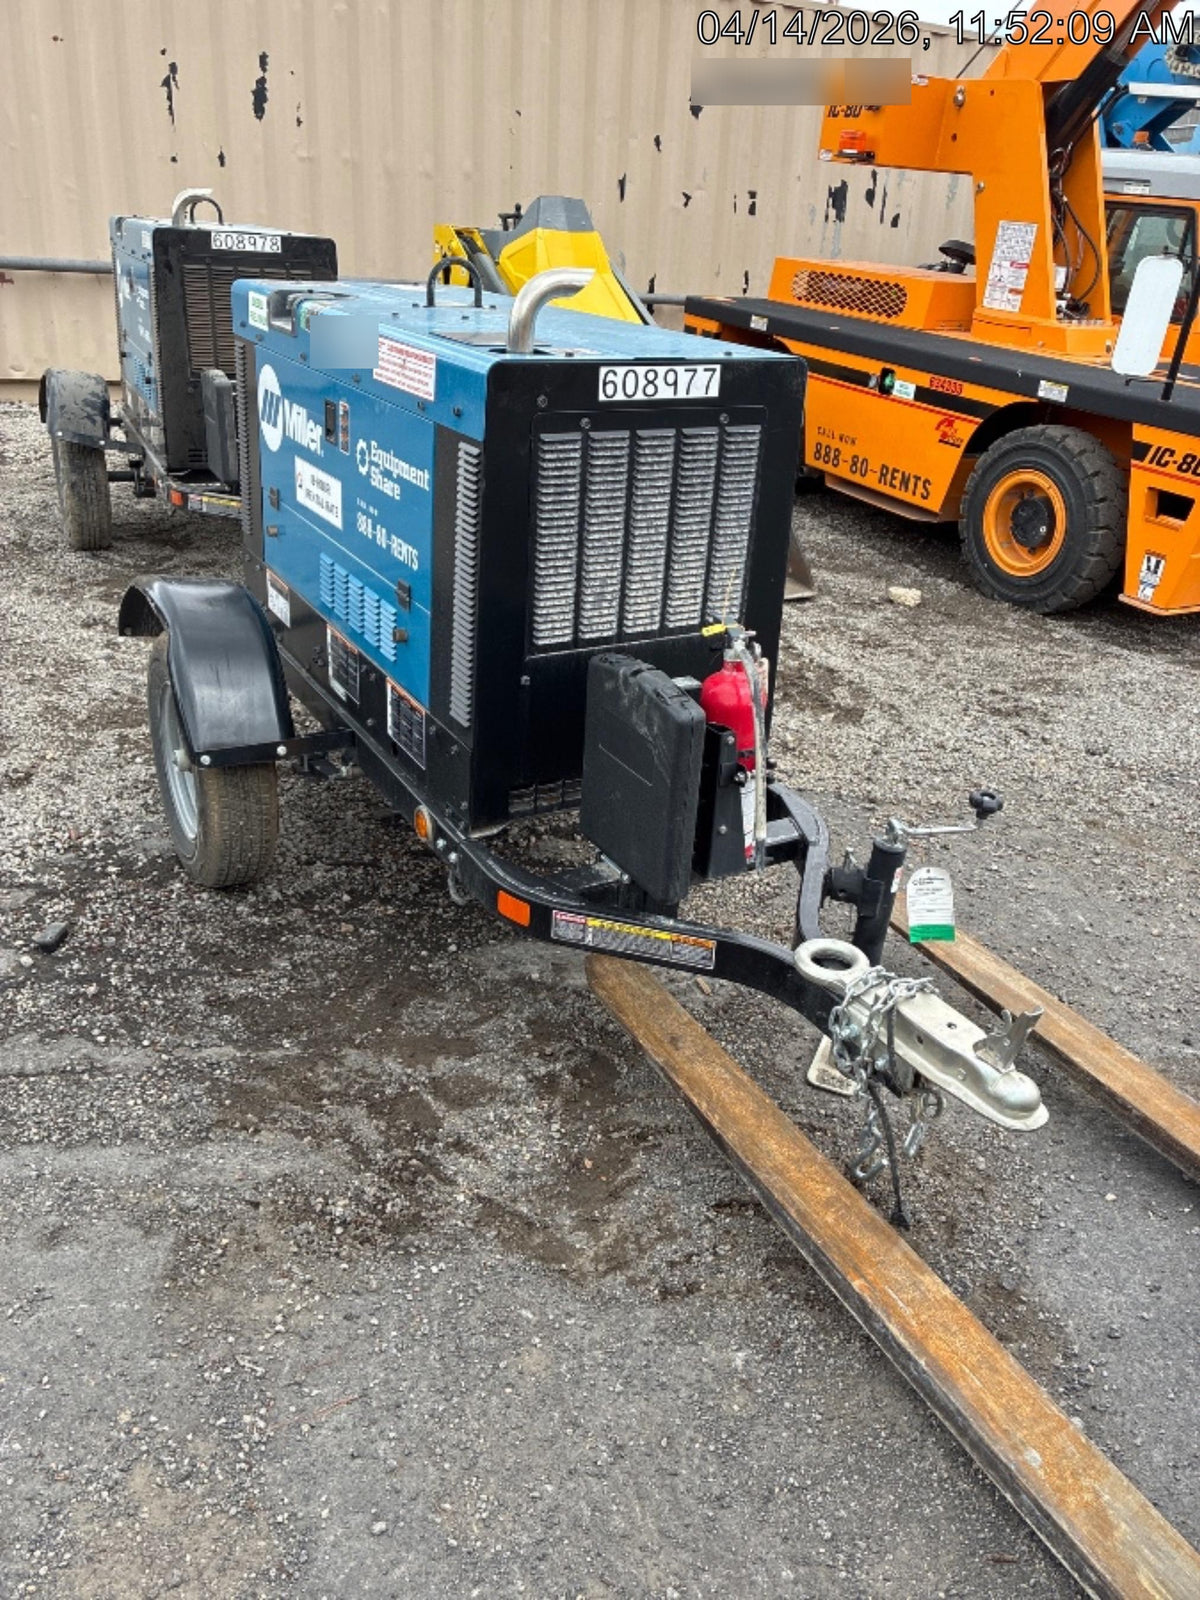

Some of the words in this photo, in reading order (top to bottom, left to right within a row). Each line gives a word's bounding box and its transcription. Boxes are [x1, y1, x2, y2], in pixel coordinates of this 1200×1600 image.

[212, 232, 281, 251] 608978
[602, 367, 717, 398] 608977
[284, 398, 323, 457] Miller
[370, 465, 400, 501] Share
[371, 440, 430, 491] Equipment
[813, 442, 932, 499] 888-80-RENTS
